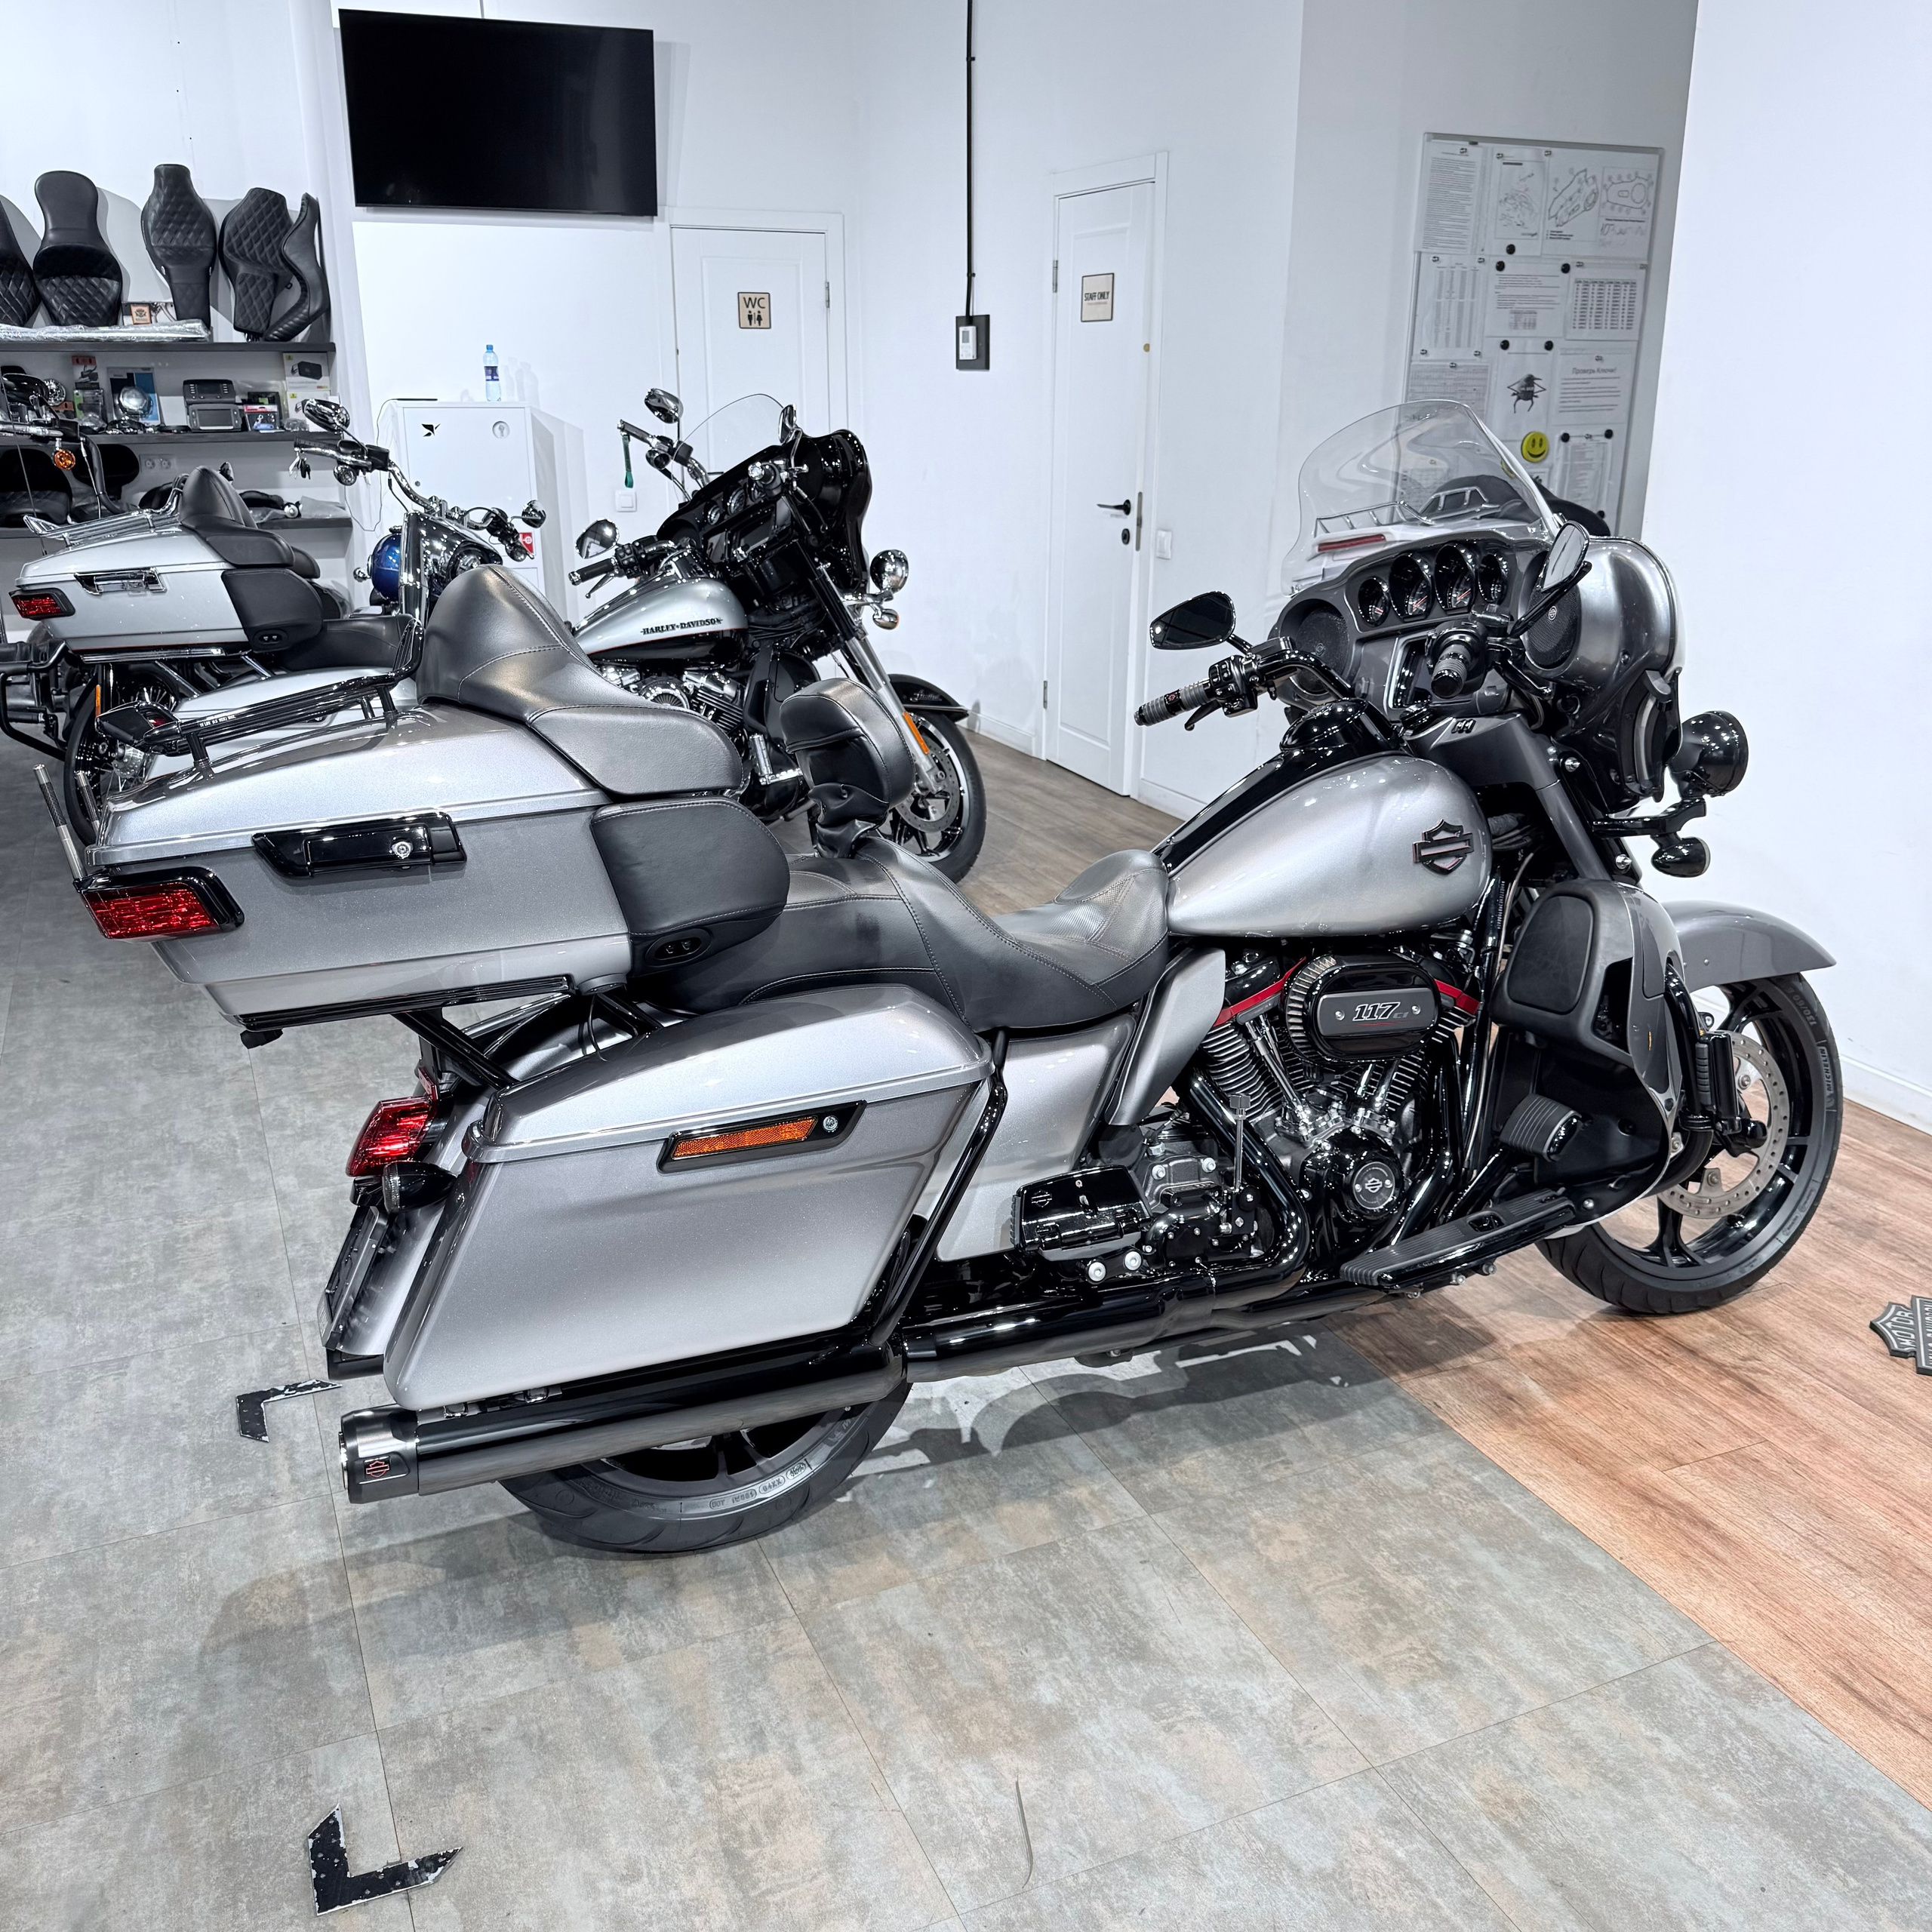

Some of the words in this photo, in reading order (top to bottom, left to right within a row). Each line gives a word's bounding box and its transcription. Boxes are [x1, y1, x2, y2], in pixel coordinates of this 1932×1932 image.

[743, 297, 765, 309] WC
[1084, 292, 1097, 301] STAFF
[1097, 291, 1109, 300] ONLY
[1352, 1001, 1401, 1021] 117
[1820, 1048, 1833, 1091] MICHELIN
[1885, 1310, 1916, 1347] MOTOR
